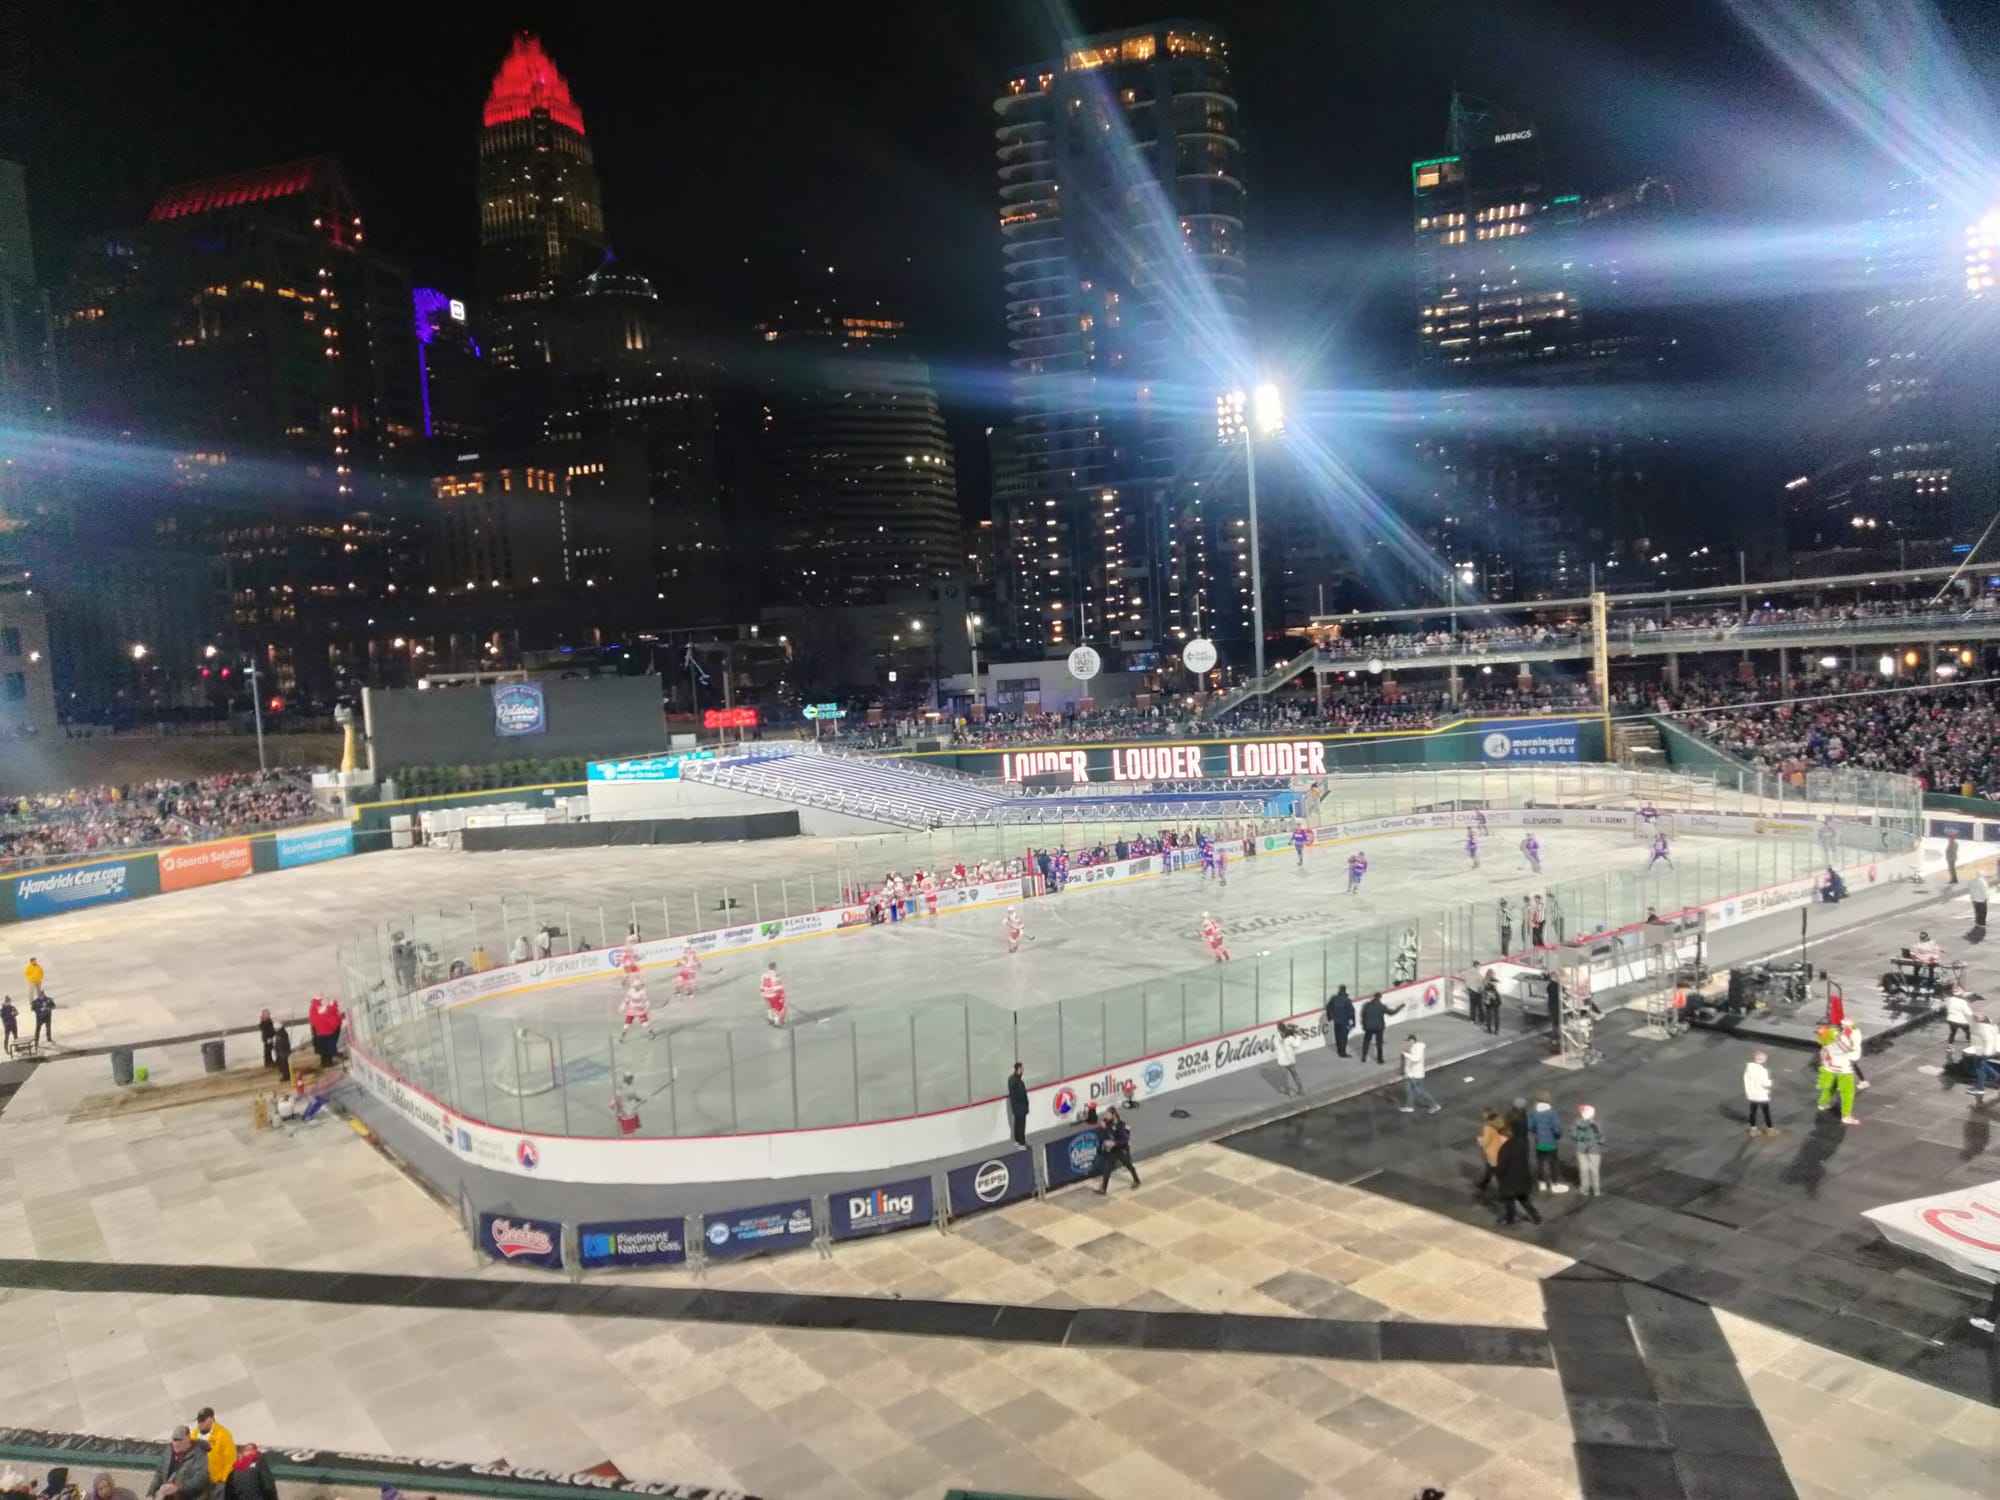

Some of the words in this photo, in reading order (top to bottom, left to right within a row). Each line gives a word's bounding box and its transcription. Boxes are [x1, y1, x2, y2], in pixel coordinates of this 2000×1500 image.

[1495, 129, 1532, 143] BARINGS
[1512, 737, 1576, 747] morningstar
[1513, 746, 1575, 755] STORAGE
[1113, 746, 1203, 781] LOUDER
[1230, 742, 1327, 777] LOUDER
[1523, 816, 1562, 825] ELEVATOR
[1605, 816, 1627, 825] ARMY
[176, 855, 209, 868] Search
[211, 848, 248, 863] Solution
[220, 857, 249, 870] Group
[550, 957, 580, 974] Parker
[581, 955, 599, 968] Poe
[1178, 1050, 1209, 1070] 2024
[1215, 1034, 1275, 1069] Outdoor
[1175, 1067, 1197, 1081] QUEEN
[1197, 1063, 1212, 1077] CITY
[977, 1170, 1007, 1188] PEPSI
[849, 1189, 914, 1219] Dilling
[616, 1232, 669, 1244] Piedmont
[617, 1241, 657, 1255] Natural
